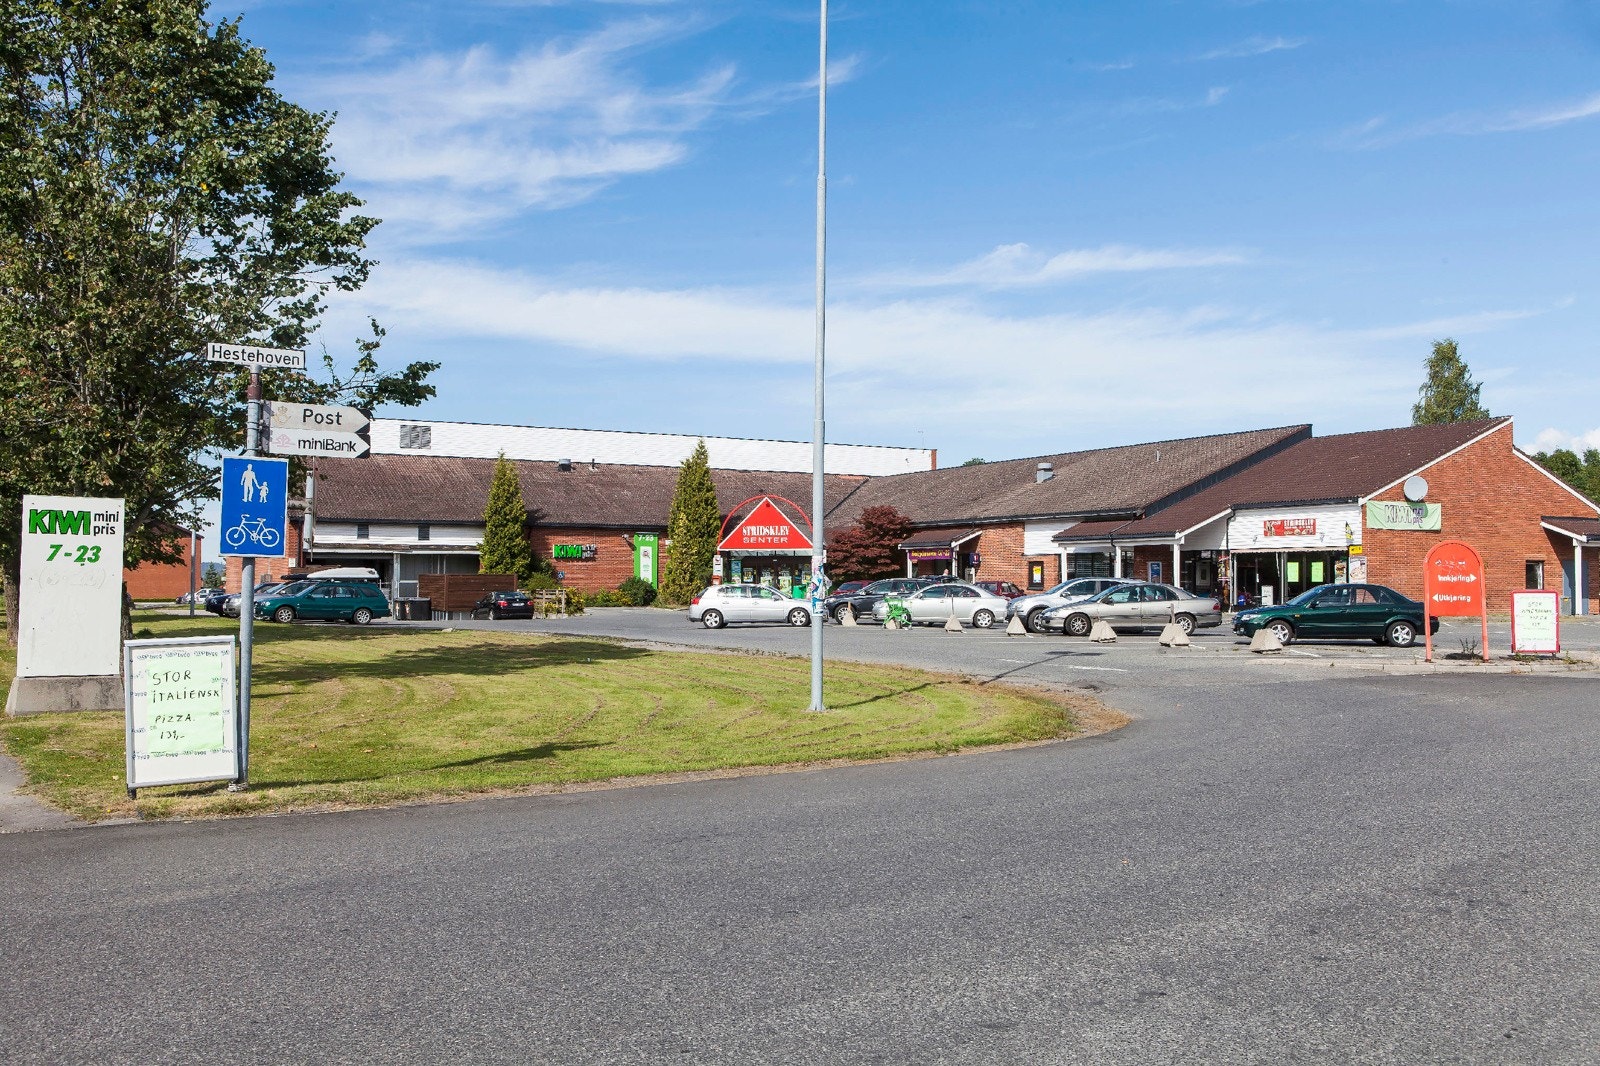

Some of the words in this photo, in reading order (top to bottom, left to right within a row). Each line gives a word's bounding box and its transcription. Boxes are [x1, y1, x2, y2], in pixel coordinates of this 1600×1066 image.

[212, 345, 300, 366] Hestehoven
[303, 408, 343, 426] Post
[298, 437, 357, 453] miniBank
[28, 508, 92, 536] KIWI
[93, 510, 120, 523] mini
[93, 523, 116, 537] pris
[742, 525, 791, 536] STRIDSKLEV
[553, 544, 582, 558] KIWI
[152, 670, 192, 685] STOR
